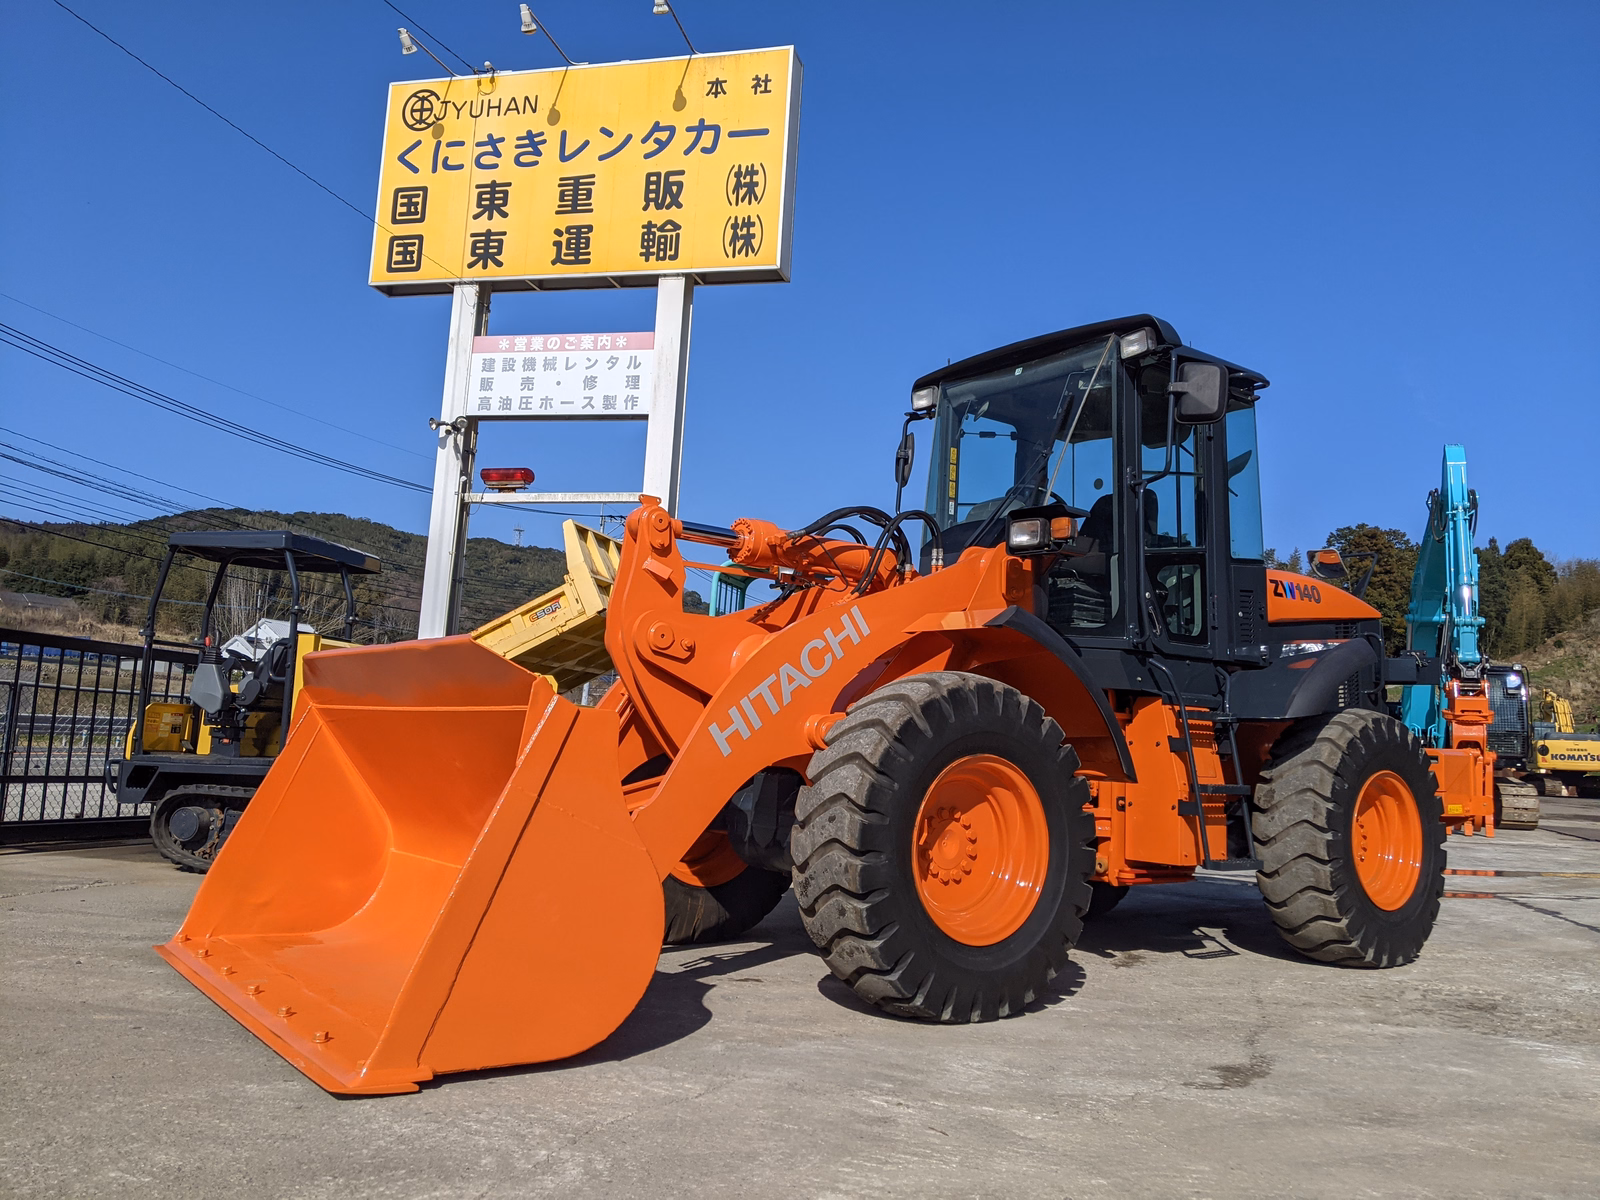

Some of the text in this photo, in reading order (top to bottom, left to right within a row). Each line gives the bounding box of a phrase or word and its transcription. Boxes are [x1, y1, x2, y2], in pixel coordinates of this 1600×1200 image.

[705, 73, 772, 98] 本社
[434, 95, 539, 121] JYUHAN
[397, 118, 770, 174] くにさきレンタカー
[481, 355, 642, 373] 建設機械レンタル
[477, 394, 640, 412] 高油圧ホース製作
[1268, 578, 1322, 604] ZW140
[707, 605, 871, 757] HITACHI
